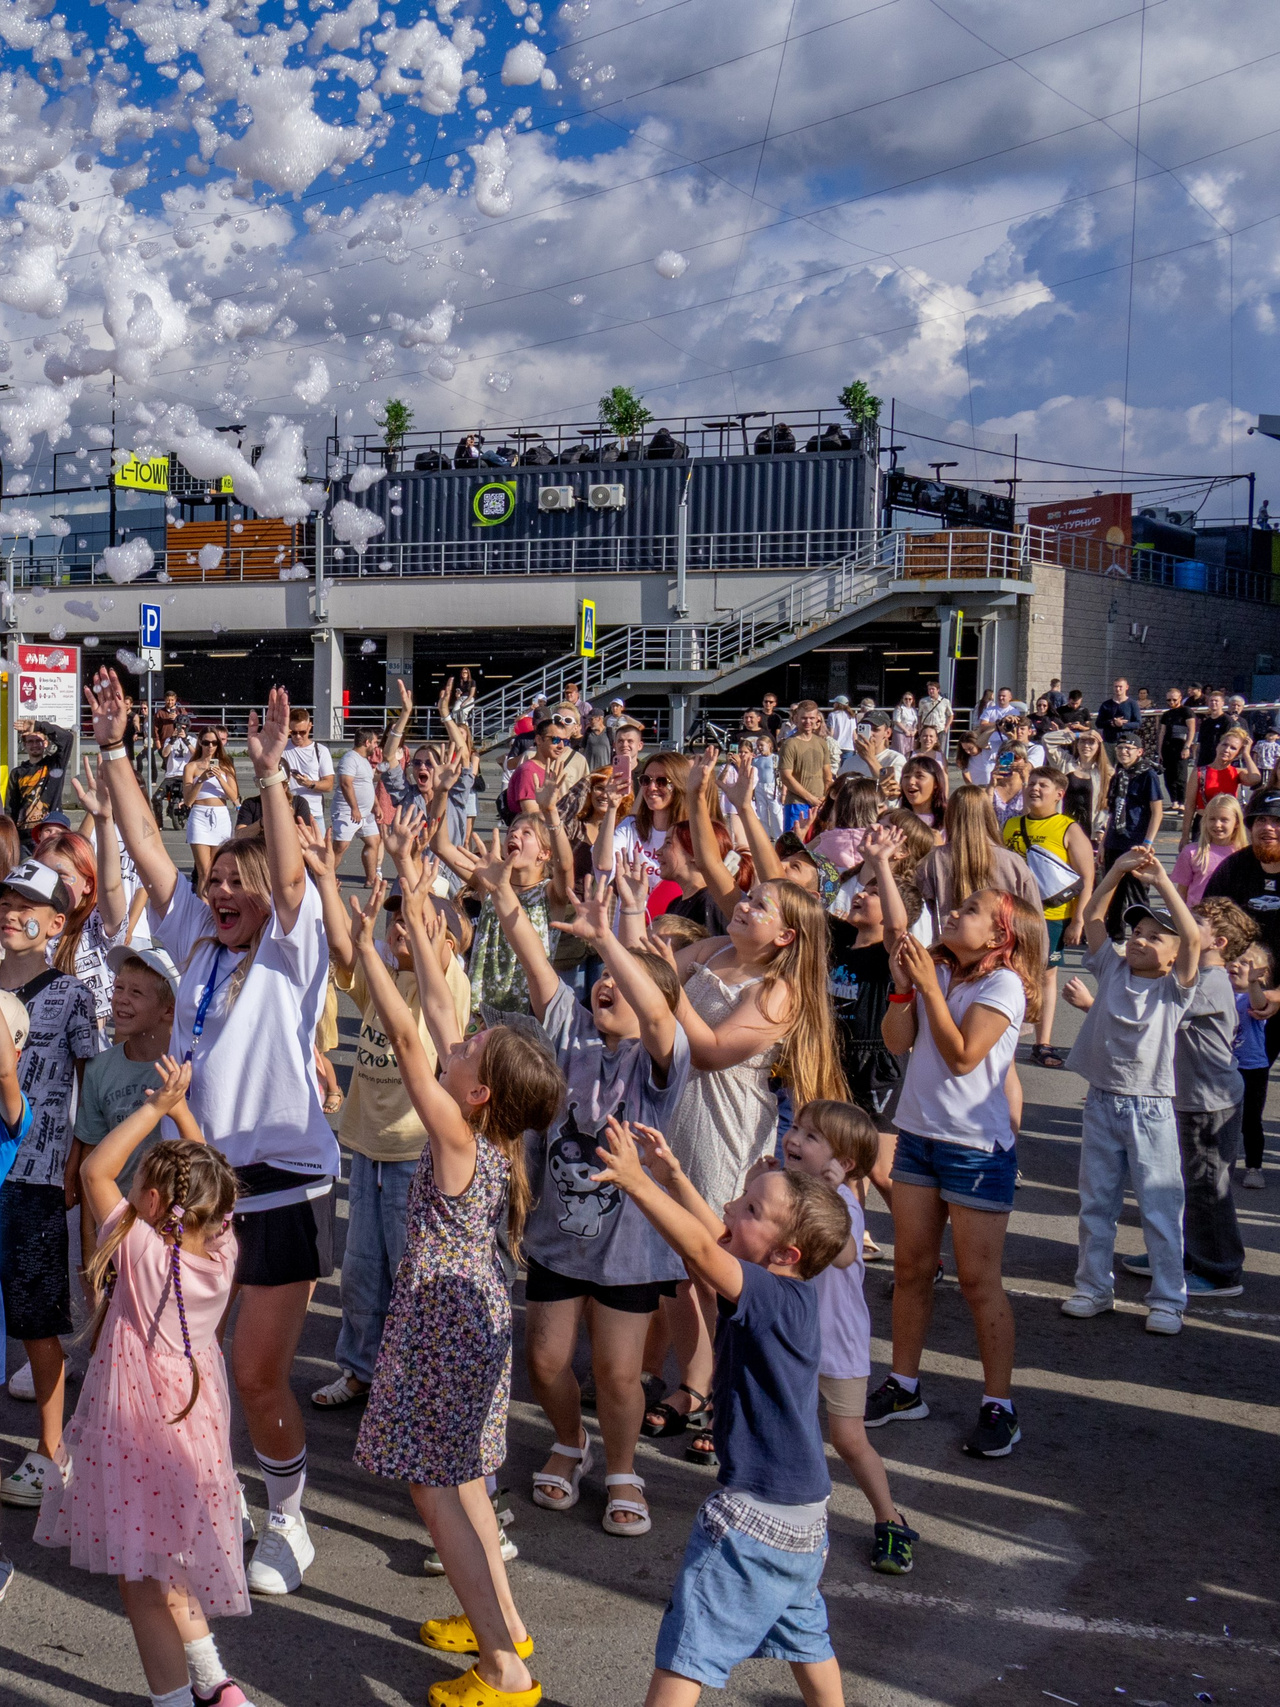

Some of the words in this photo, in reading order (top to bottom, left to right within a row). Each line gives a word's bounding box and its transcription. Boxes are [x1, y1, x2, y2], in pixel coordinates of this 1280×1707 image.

[147, 609, 158, 643] P
[361, 1024, 390, 1048] NE
[104, 1084, 139, 1106] STREET
[271, 1515, 286, 1524] FILA
